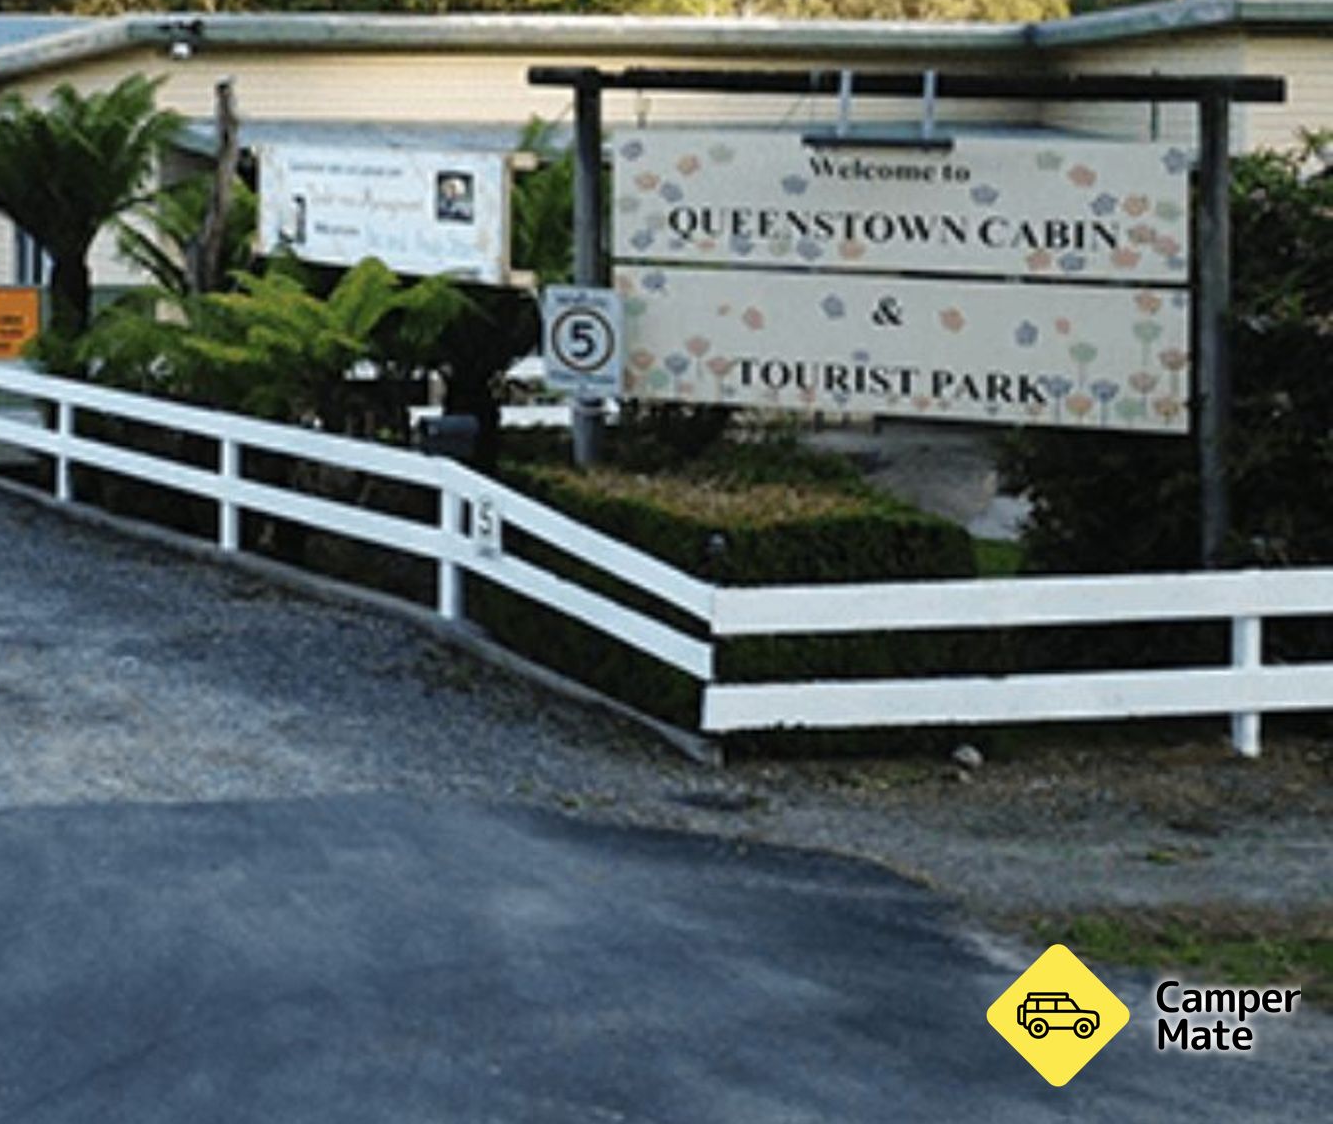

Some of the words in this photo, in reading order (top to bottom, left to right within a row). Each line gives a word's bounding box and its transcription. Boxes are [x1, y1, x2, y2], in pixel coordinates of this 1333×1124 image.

[809, 156, 933, 182] Welcome
[940, 163, 971, 182] to
[667, 205, 969, 244] QUEENSTOWN
[978, 214, 1120, 250] CABIN
[871, 296, 903, 327] &
[569, 321, 595, 359] 5
[734, 358, 919, 396] TOURIST
[931, 370, 1047, 406] PARK
